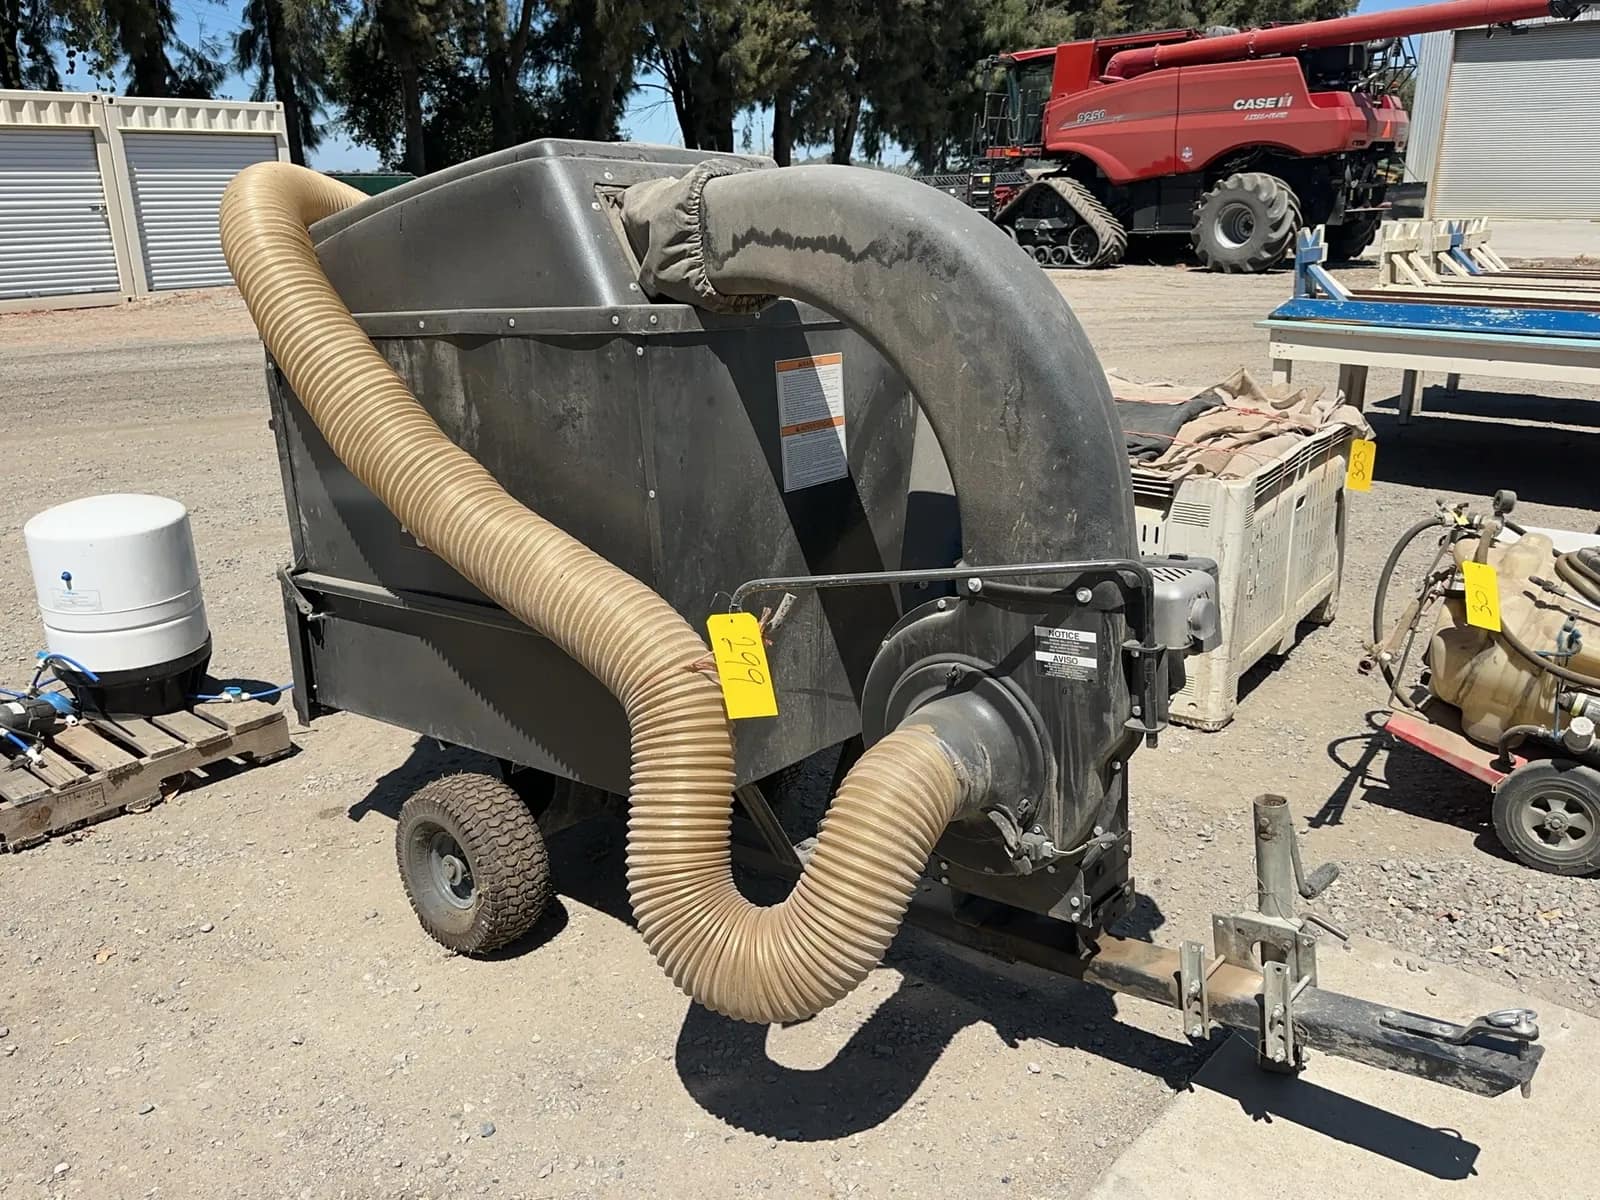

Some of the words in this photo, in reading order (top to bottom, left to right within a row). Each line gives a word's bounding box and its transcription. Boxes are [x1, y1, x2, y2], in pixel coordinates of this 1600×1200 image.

[1233, 97, 1277, 110] CASE
[1048, 629, 1080, 640] NOTICE
[1053, 655, 1078, 665] AVISO
